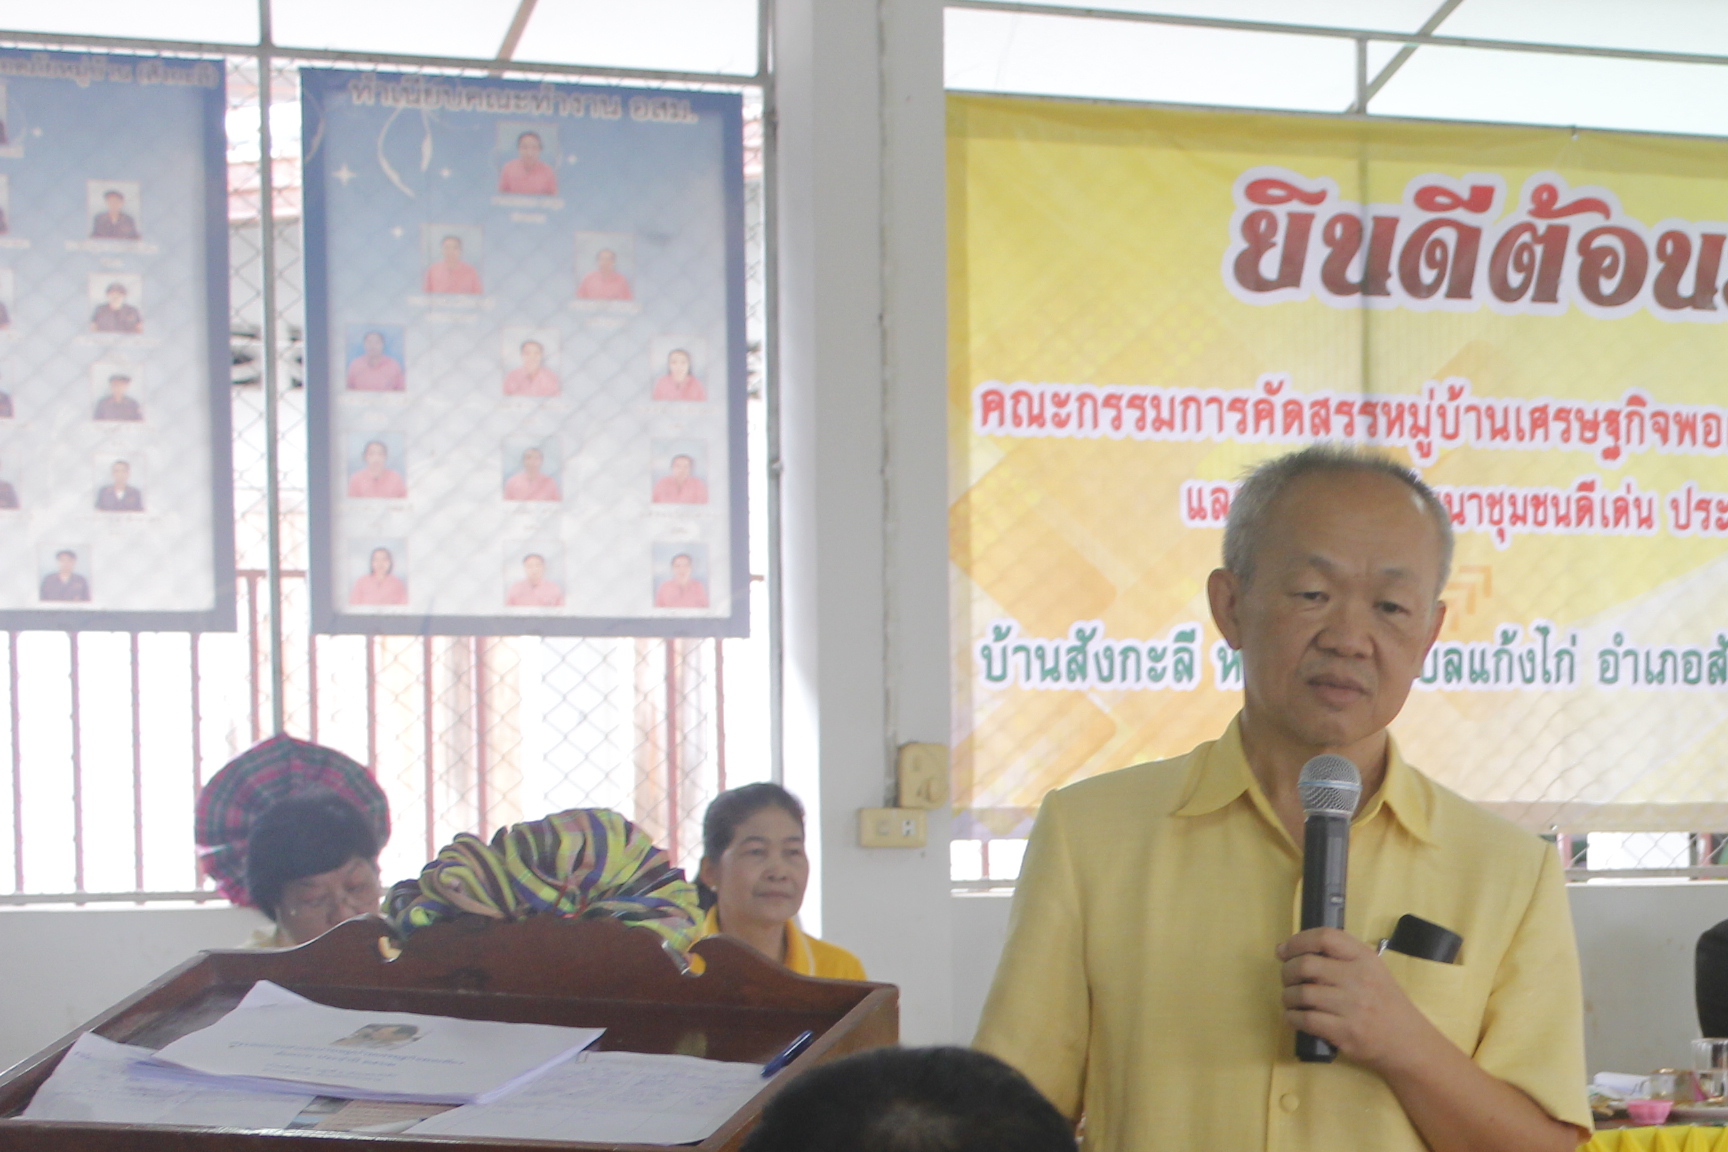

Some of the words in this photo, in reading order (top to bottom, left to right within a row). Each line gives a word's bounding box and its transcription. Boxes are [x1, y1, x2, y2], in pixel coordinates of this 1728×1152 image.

[1186, 485, 1241, 521] แล
[1436, 480, 1655, 544] นาชุมชนดีเด่น
[980, 624, 1197, 684] บ้านสังกะลี
[1419, 624, 1577, 685] บลแก้งไก่
